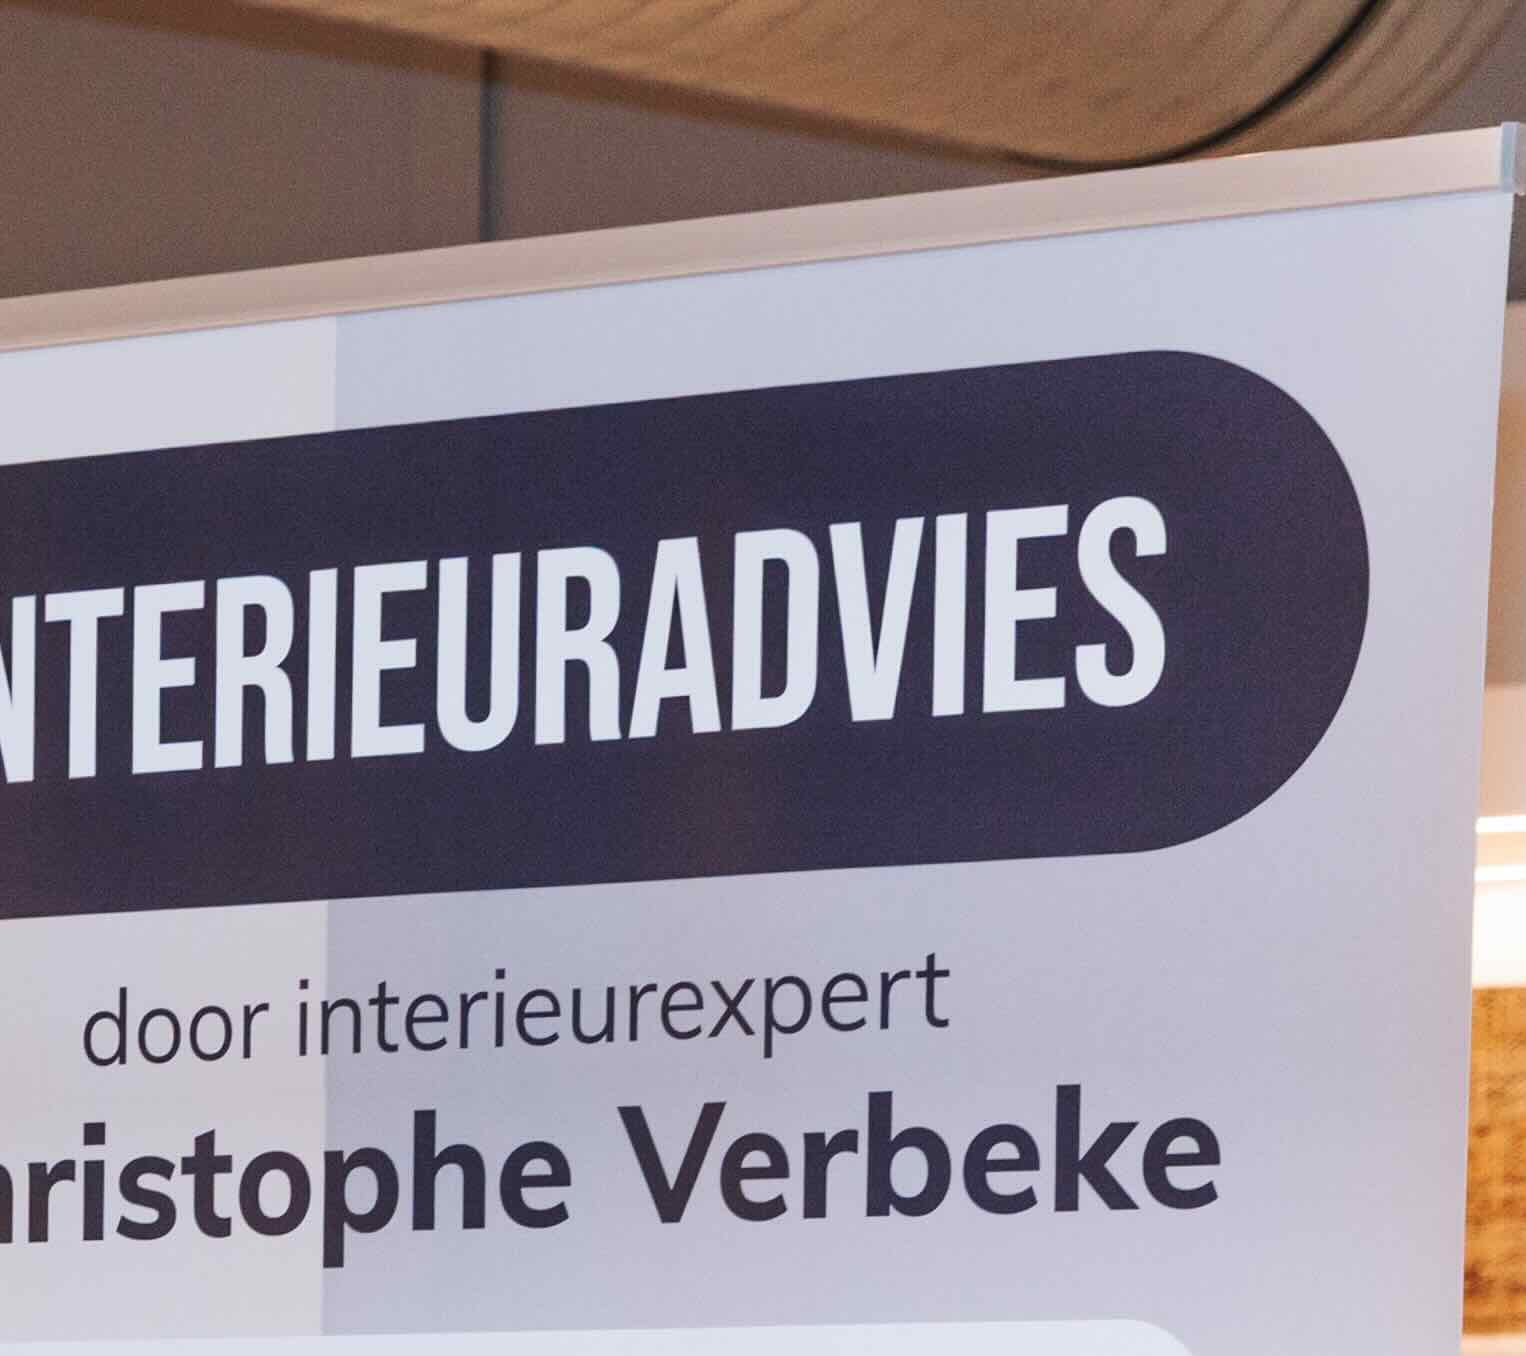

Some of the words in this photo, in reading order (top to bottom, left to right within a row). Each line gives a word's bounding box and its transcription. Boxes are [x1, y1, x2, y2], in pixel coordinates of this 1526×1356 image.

[83, 987, 271, 1067] door
[297, 951, 952, 1060] interieurexpert
[617, 1083, 1222, 1225] Verbeke
